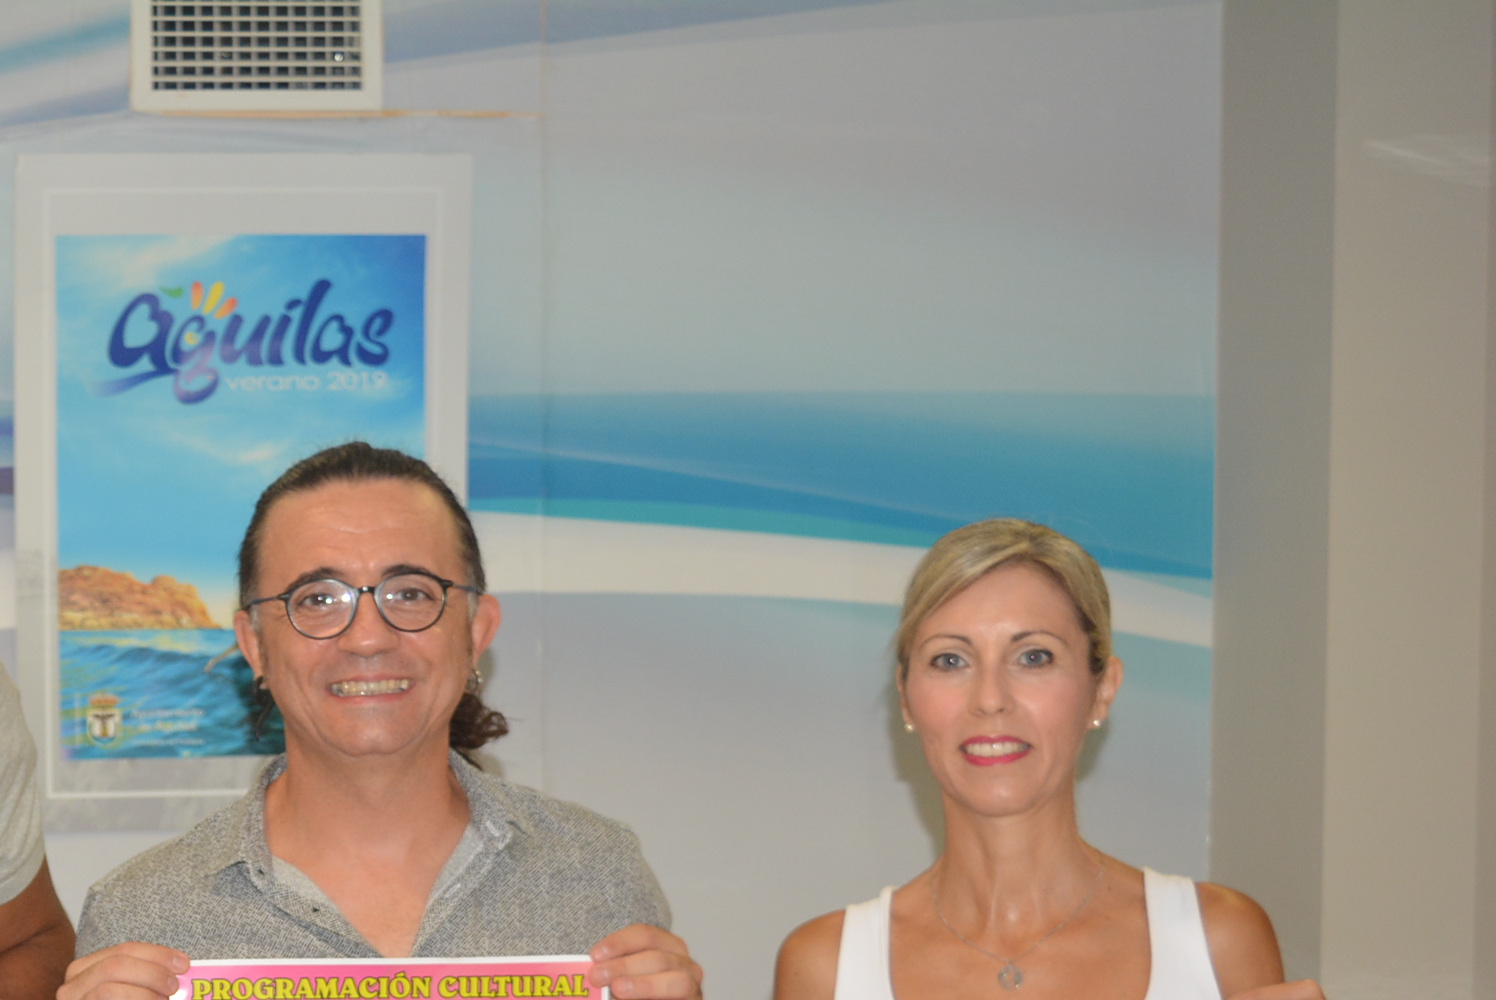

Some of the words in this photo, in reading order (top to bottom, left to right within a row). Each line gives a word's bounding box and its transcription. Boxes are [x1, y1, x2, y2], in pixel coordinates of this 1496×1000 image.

[224, 372, 322, 392] verano
[326, 370, 390, 393] 2019
[438, 974, 590, 999] CULTURAL
